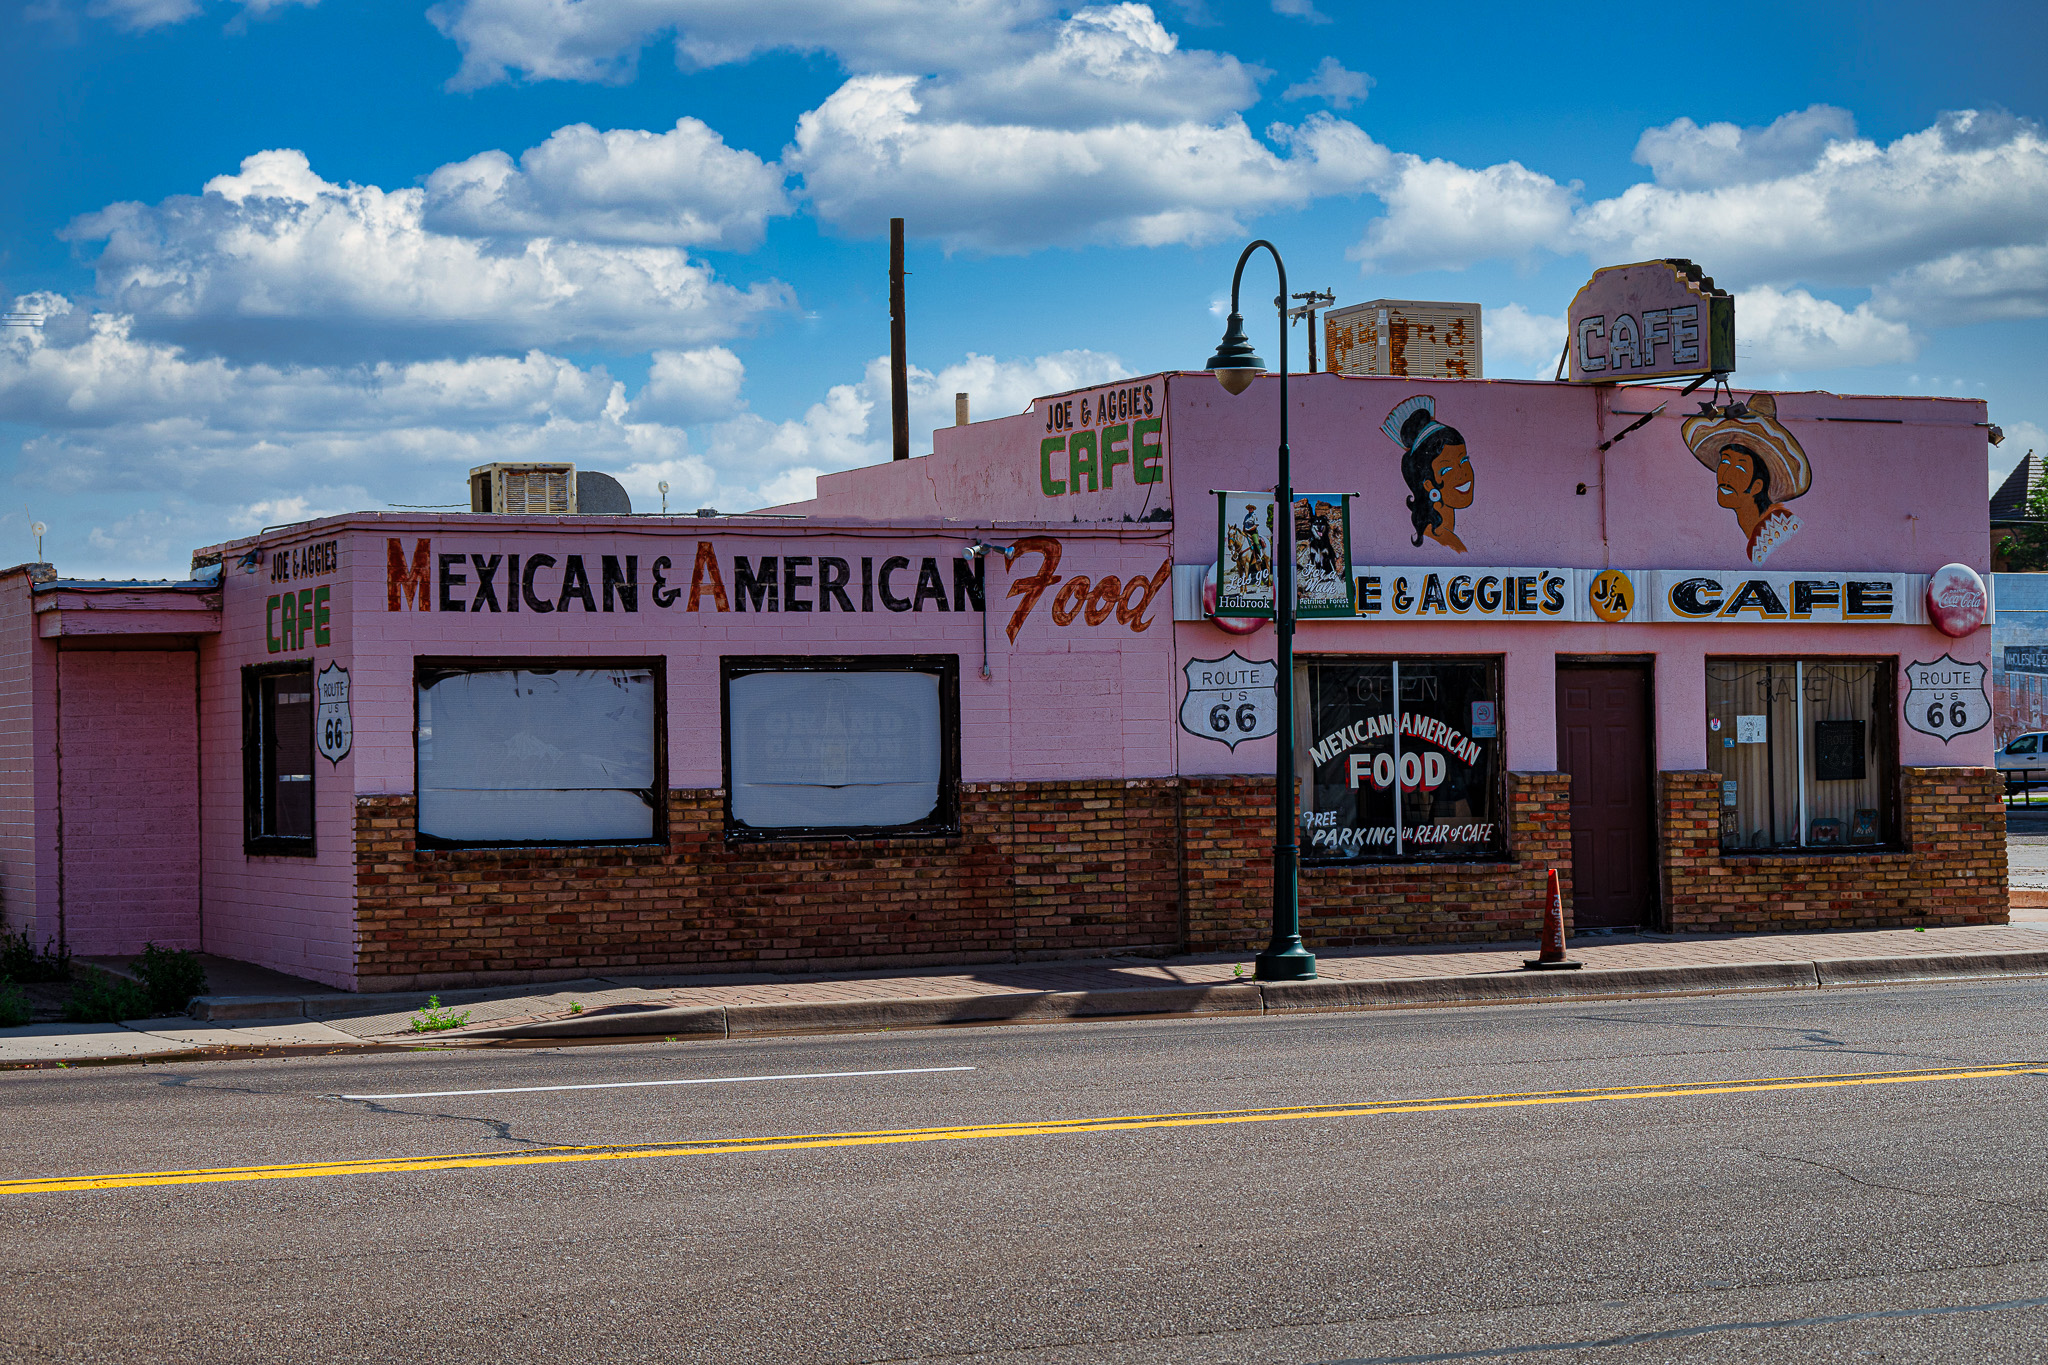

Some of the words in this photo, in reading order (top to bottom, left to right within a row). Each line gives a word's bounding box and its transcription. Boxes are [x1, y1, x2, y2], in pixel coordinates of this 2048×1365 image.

[1577, 304, 1699, 372] CAFE
[1046, 400, 1074, 433] JOE
[1080, 397, 1092, 428] &
[1095, 384, 1154, 426] AGGIES
[1040, 416, 1164, 498] CAFE
[270, 550, 290, 584] JOE
[292, 548, 300, 581] &
[300, 539, 338, 579] AGGIES
[386, 537, 639, 613] MEXICAN
[651, 555, 682, 609] &
[686, 541, 985, 613] AMERICAN
[1301, 563, 1325, 579] For
[1328, 570, 1338, 580] a
[1004, 536, 1172, 646] Food
[1225, 573, 1252, 592] Lets
[1255, 568, 1269, 587] go
[1305, 579, 1338, 595] Walk
[1392, 576, 1415, 614] &
[1415, 570, 1566, 616] AGGIE'S
[1218, 595, 1271, 609] Holbrook
[1667, 577, 1895, 621] CAFE
[267, 584, 331, 654] CAFE
[323, 681, 345, 697] ROUTE
[1202, 669, 1260, 685] ROUTE
[1920, 671, 1971, 685] ROUTE
[1209, 703, 1257, 732] 66
[1926, 700, 1967, 728] 66
[325, 717, 343, 750] 66
[1308, 713, 1394, 768] MEXICAN
[1400, 712, 1482, 767] AMERICAN
[1344, 751, 1447, 793] FOOD
[1303, 810, 1338, 830] FREE
[1312, 826, 1396, 847] PARKING
[1402, 826, 1413, 841] in
[1413, 824, 1450, 845] REAR
[1450, 825, 1462, 842] of
[1462, 823, 1495, 843] CAFE
